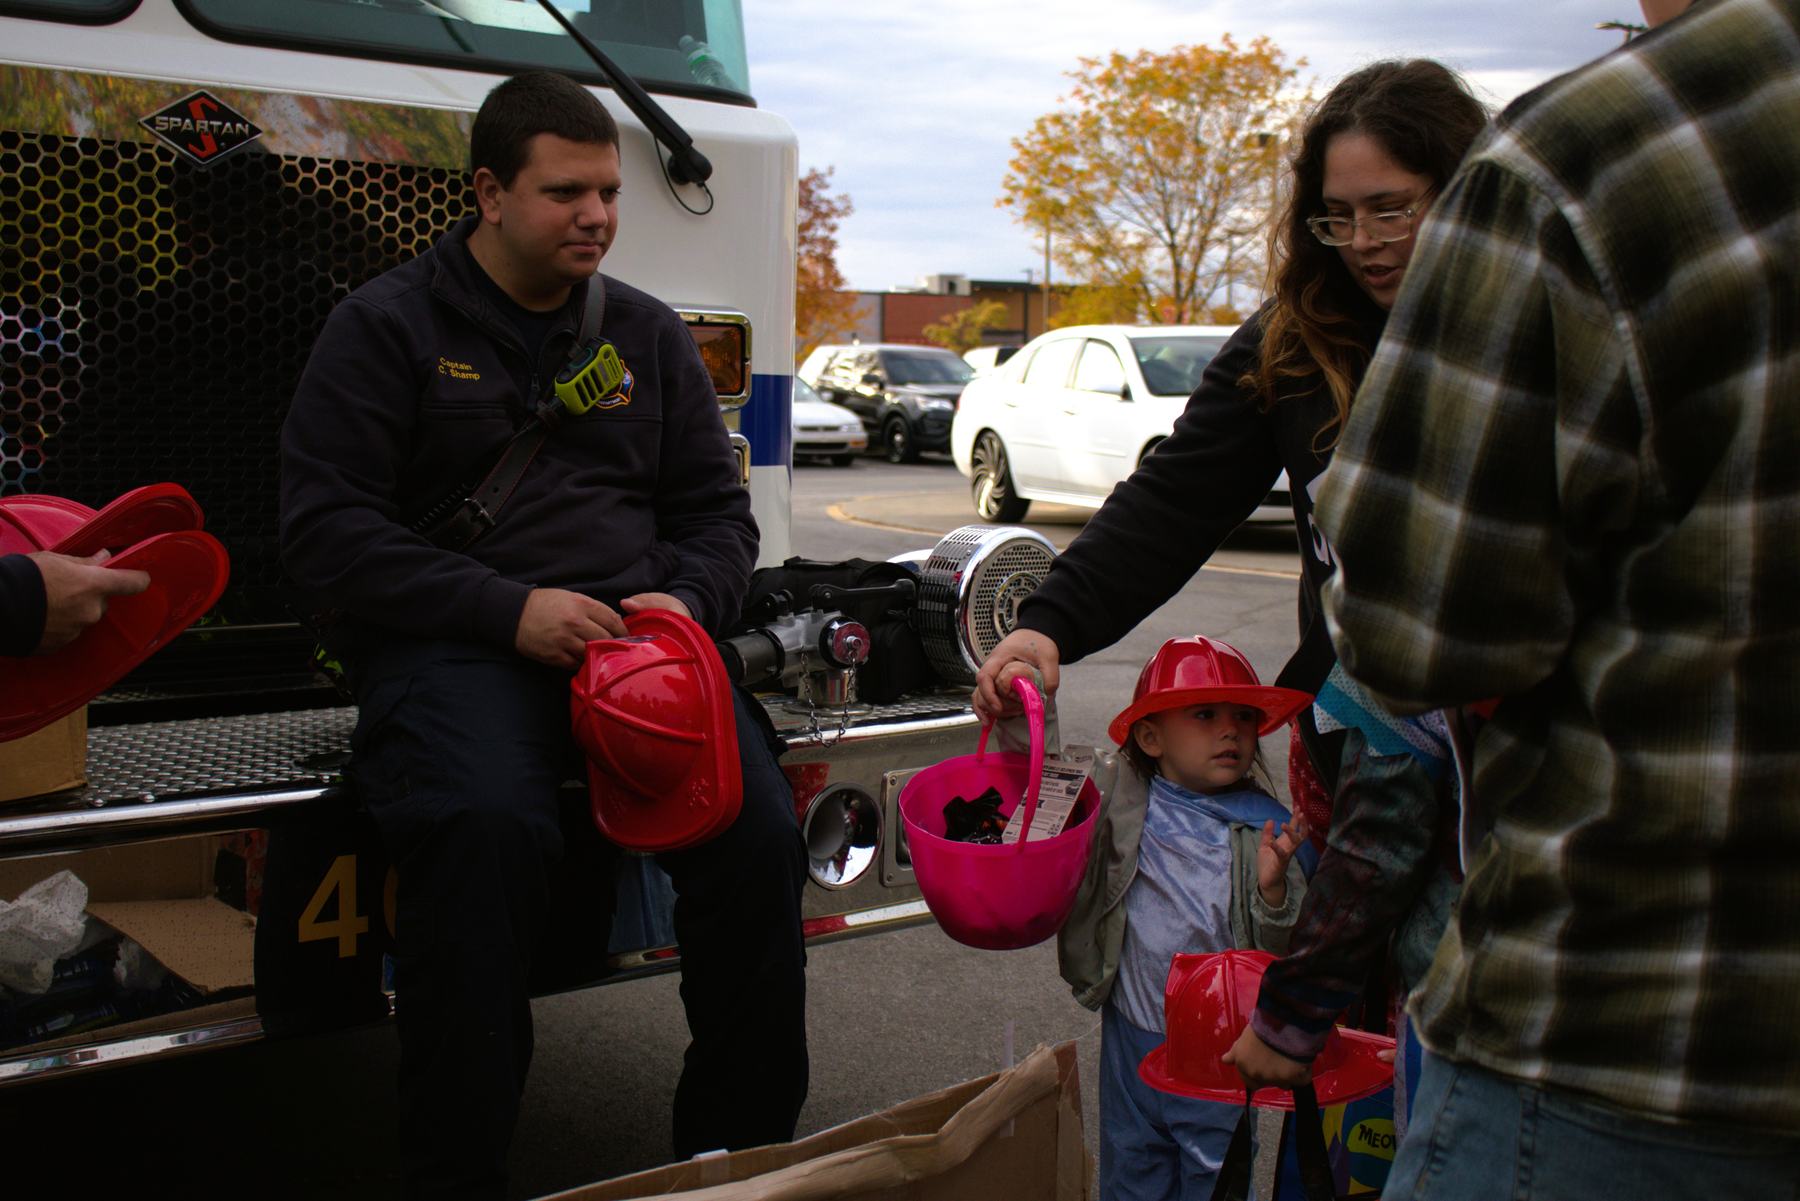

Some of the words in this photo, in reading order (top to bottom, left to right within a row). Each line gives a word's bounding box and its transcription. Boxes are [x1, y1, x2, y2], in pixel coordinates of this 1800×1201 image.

[155, 116, 249, 138] SPARTAN
[439, 357, 473, 371] Captain
[449, 368, 481, 381] Shamp
